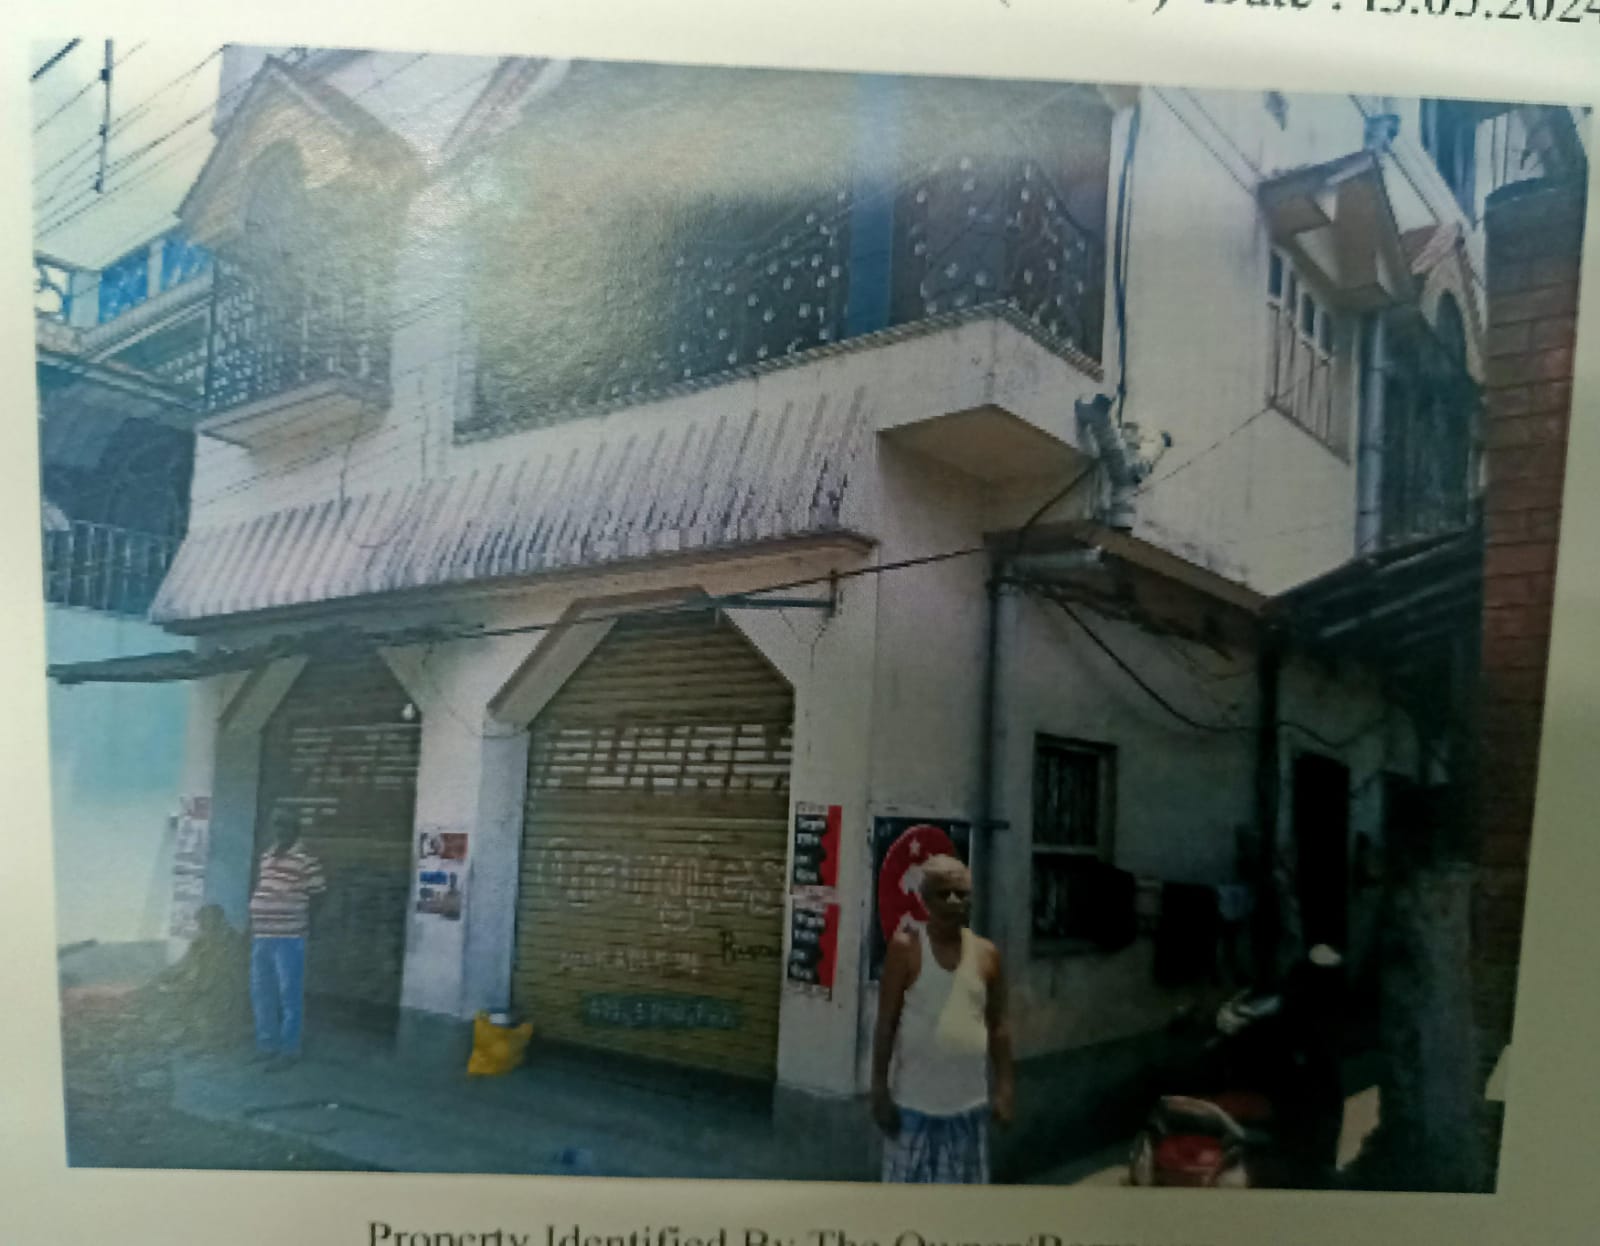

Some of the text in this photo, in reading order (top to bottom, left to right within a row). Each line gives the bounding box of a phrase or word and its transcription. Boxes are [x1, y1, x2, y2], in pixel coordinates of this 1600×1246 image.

[1366, 0, 1600, 24] ..2024
[743, 1228, 796, 1246] B
[807, 1228, 880, 1246] Th
